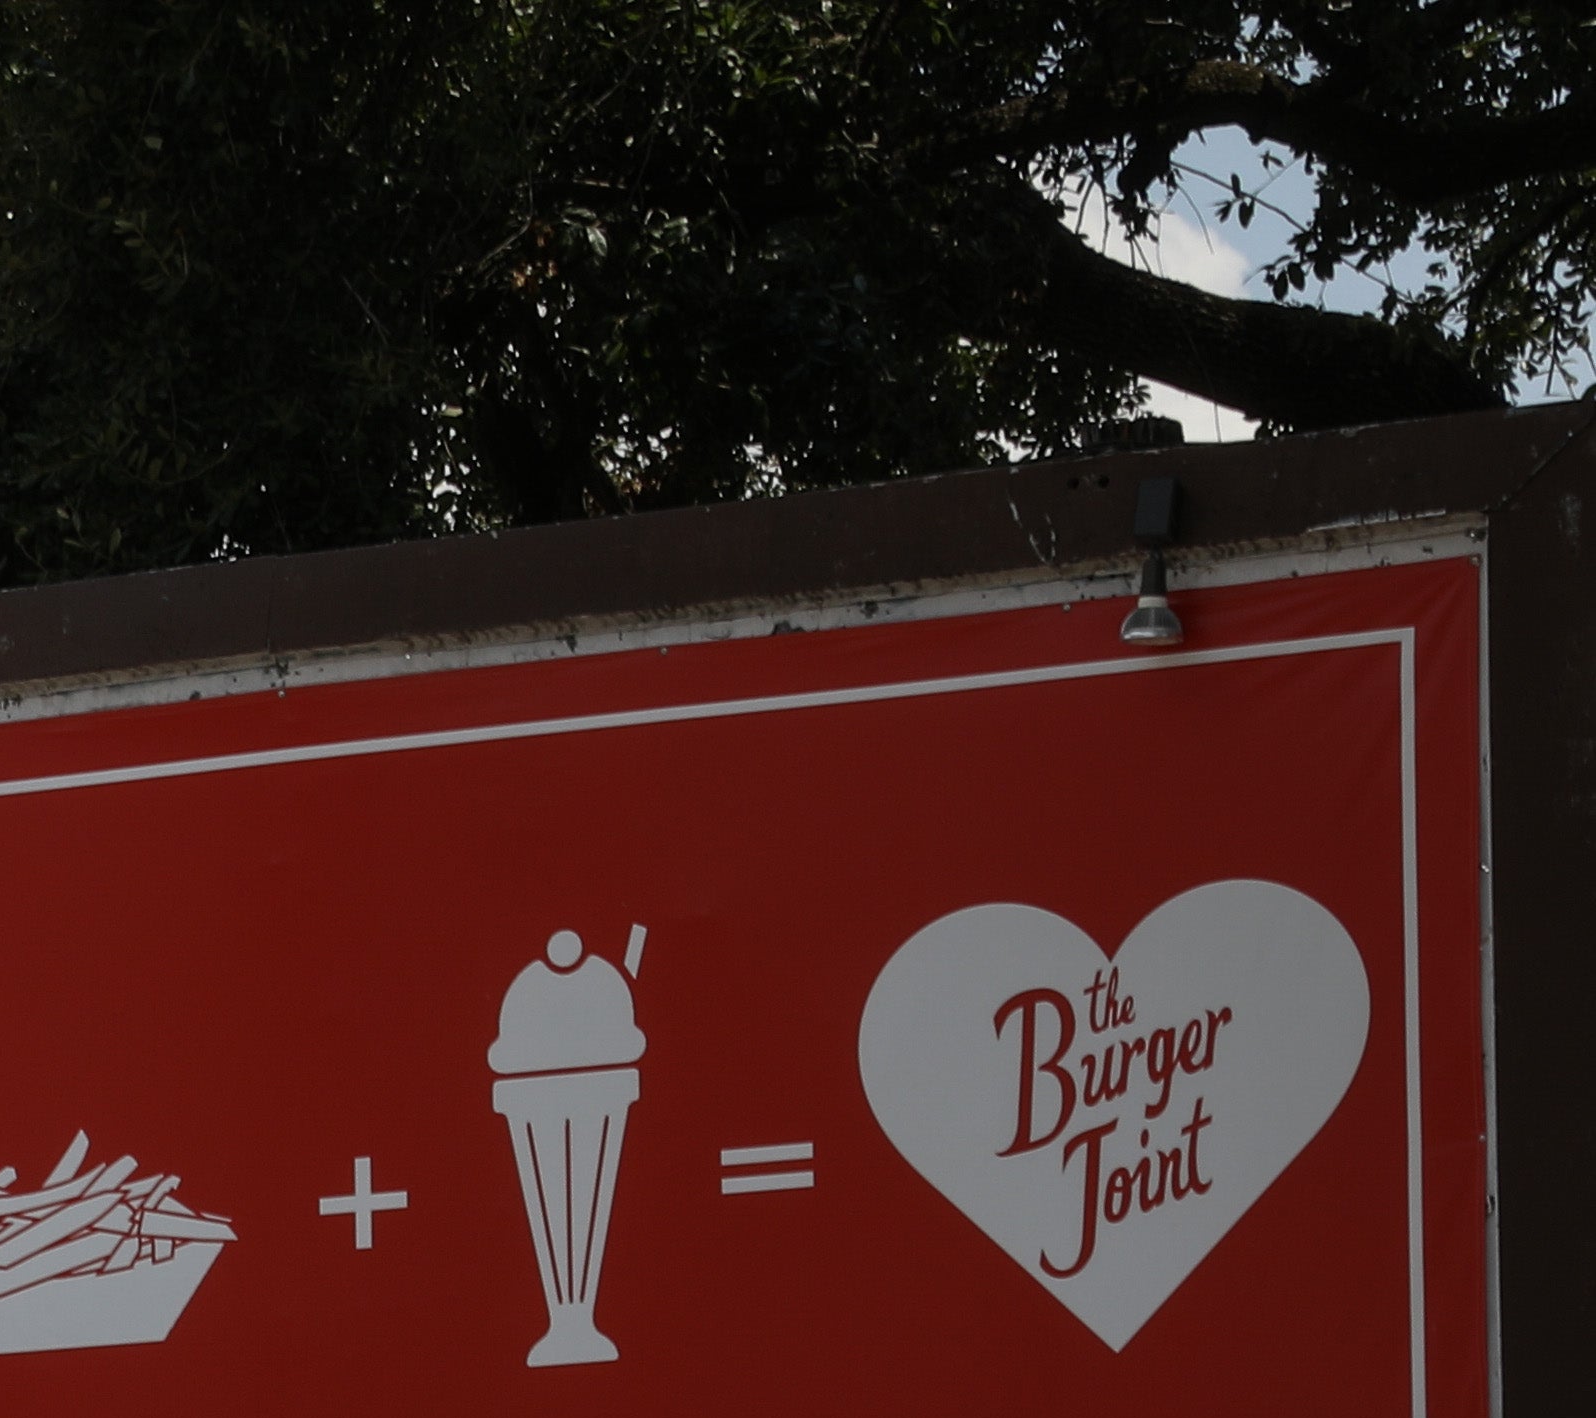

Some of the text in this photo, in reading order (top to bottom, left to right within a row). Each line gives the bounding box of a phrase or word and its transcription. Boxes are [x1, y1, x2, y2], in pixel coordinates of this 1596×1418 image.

[993, 987, 1232, 1158] Burger
[1083, 965, 1137, 1034] the
[1039, 1097, 1213, 1279] Joint
